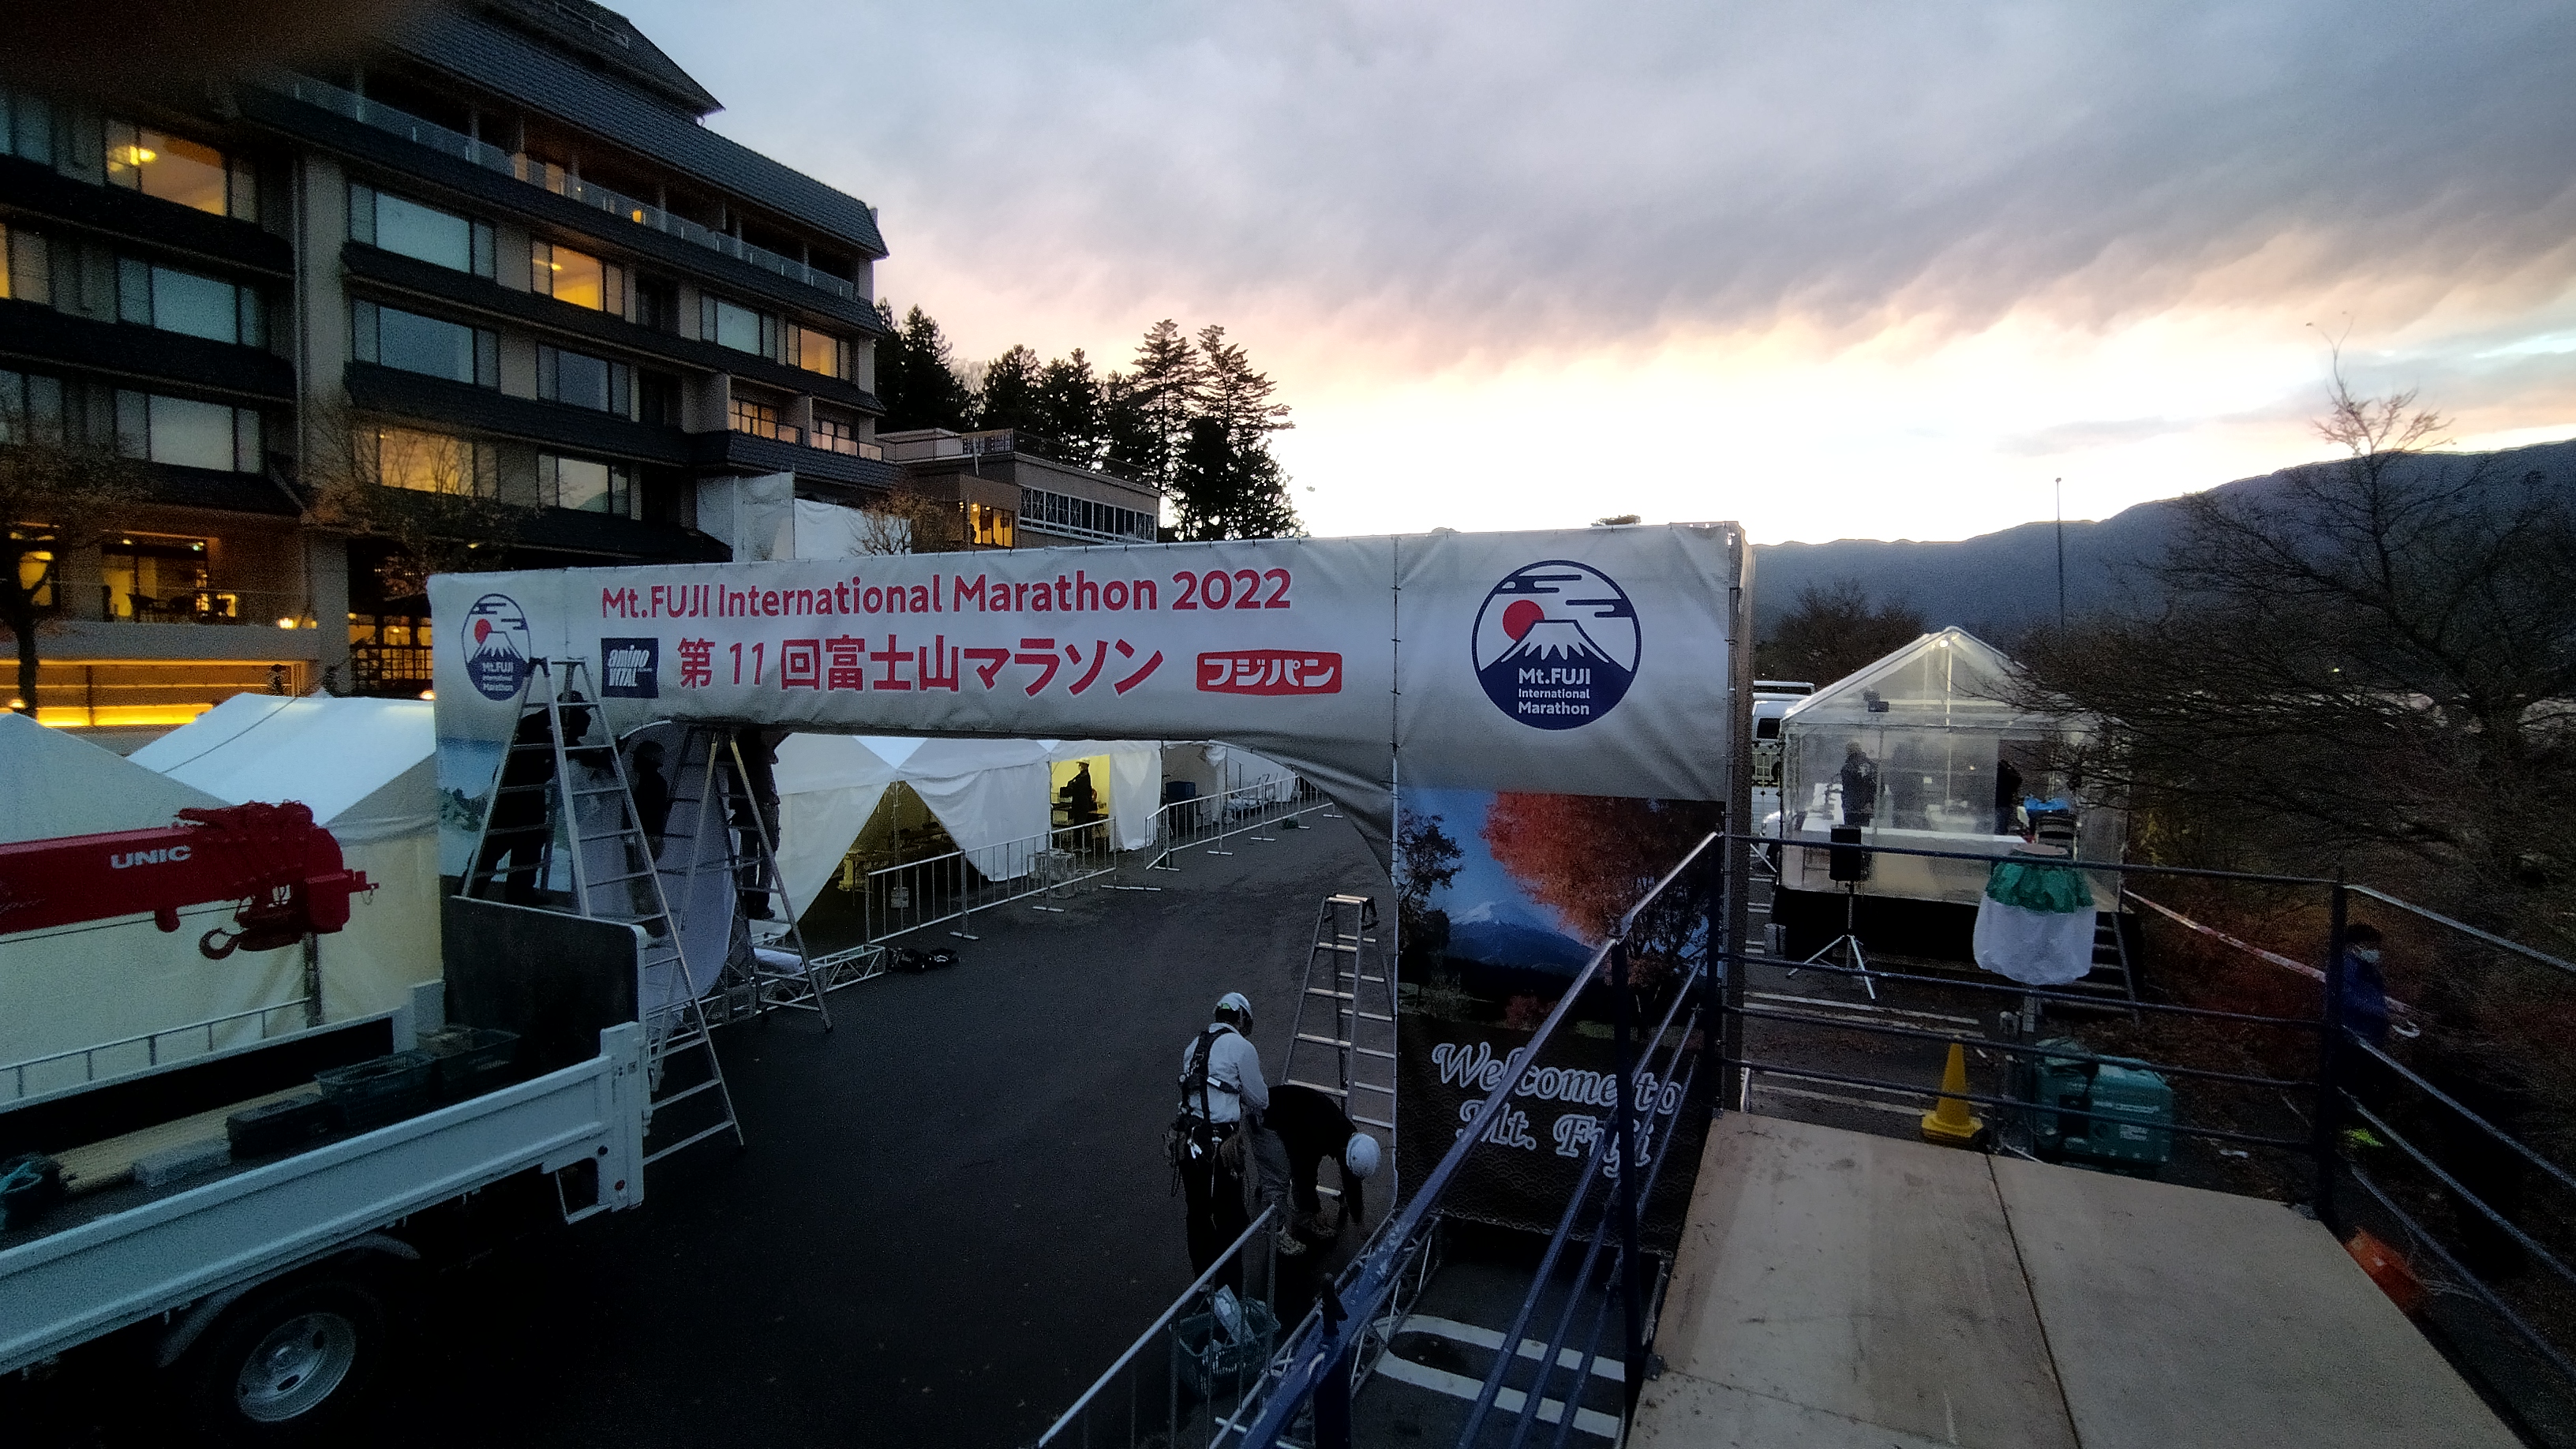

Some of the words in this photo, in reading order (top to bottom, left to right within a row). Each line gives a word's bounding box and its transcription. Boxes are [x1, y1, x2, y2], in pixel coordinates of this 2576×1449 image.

[602, 584, 710, 619] Mt.FUJI
[718, 576, 942, 617] International
[953, 570, 1158, 612] Marathon
[1172, 569, 1292, 611] 2022
[608, 644, 650, 668] amino
[676, 634, 1164, 696] 第11回富士山マラソン
[1204, 658, 1335, 687] フジパン
[1518, 668, 1590, 684] Mt.FUJI
[1518, 688, 1590, 698] International
[1518, 701, 1590, 715] Marathon
[110, 845, 191, 869] UNIC
[1634, 1071, 1683, 1115] to
